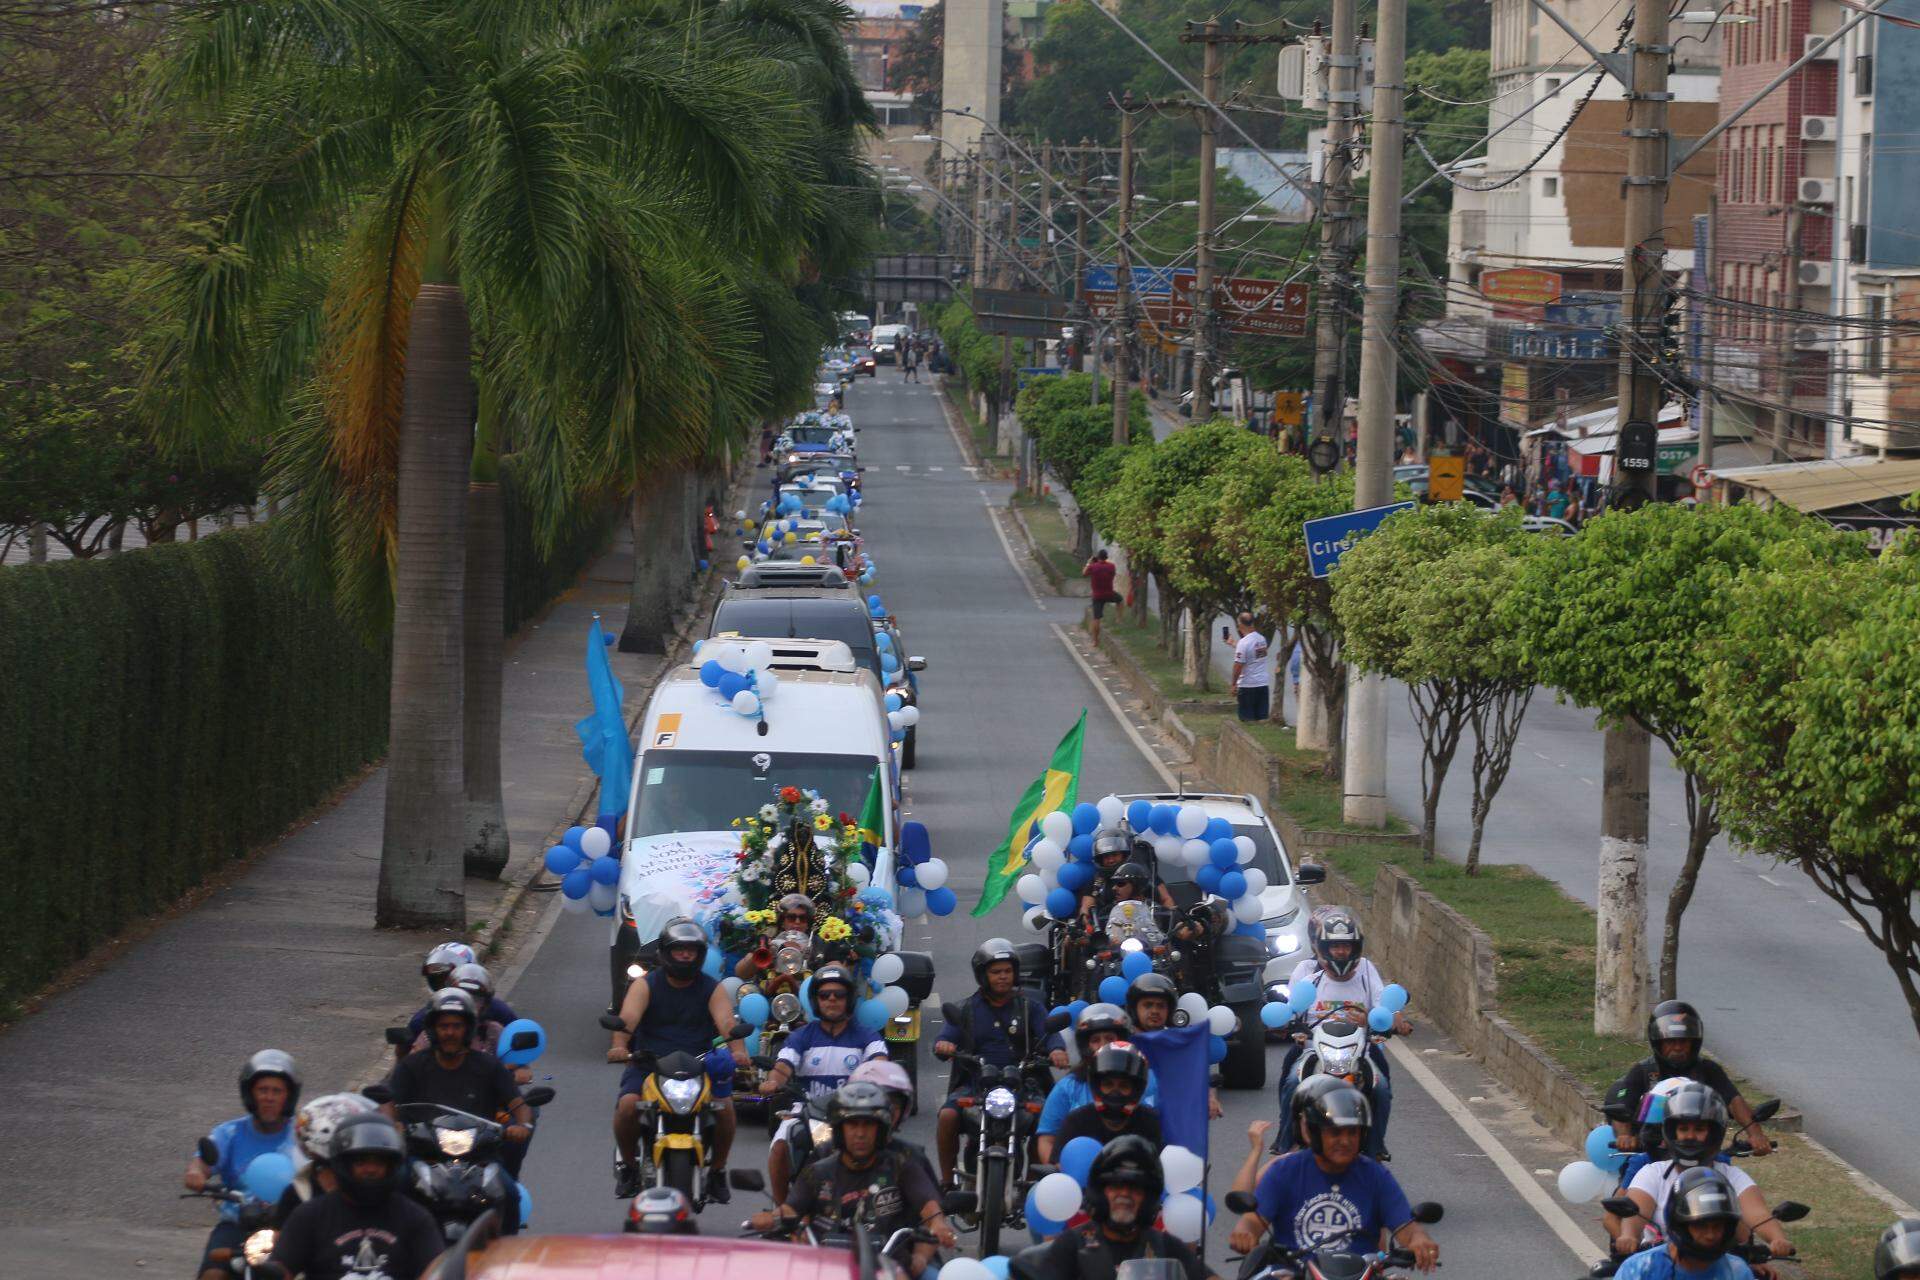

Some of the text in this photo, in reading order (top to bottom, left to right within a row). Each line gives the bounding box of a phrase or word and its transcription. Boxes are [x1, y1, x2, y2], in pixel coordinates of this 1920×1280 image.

[1238, 284, 1269, 296] Velha
[1655, 450, 1691, 460] OSTA
[1622, 457, 1649, 468] 1559
[656, 733, 673, 745] F
